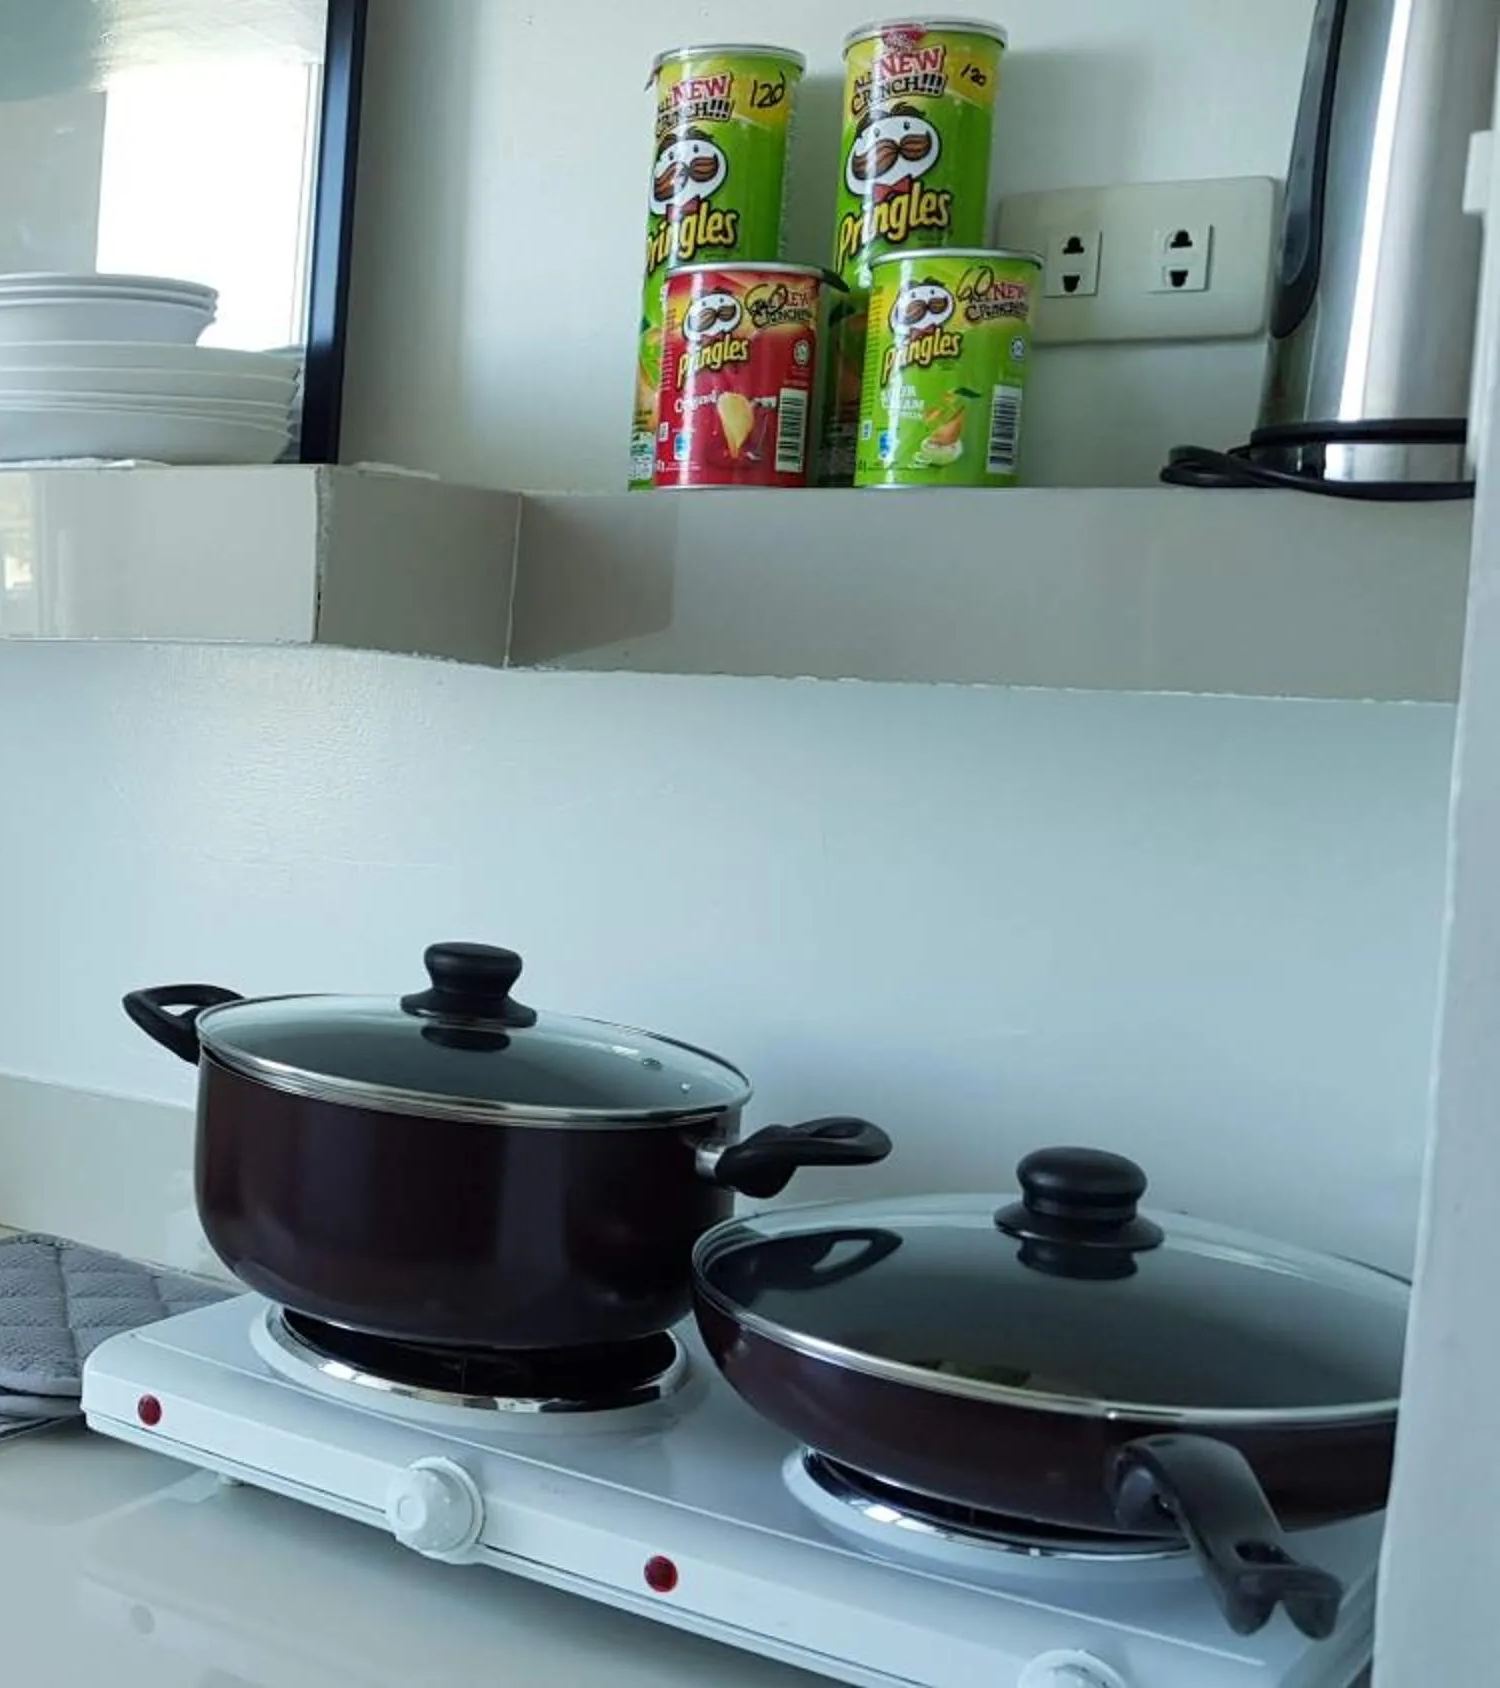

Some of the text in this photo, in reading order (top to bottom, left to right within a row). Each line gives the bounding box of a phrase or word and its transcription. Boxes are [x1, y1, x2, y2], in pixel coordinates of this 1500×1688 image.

[879, 48, 940, 77] NEW
[671, 75, 728, 106] NEW
[750, 70, 786, 109] 120
[851, 73, 943, 115] CRNCH!!!
[677, 334, 748, 389] Pringles
[880, 328, 961, 386] Pringles
